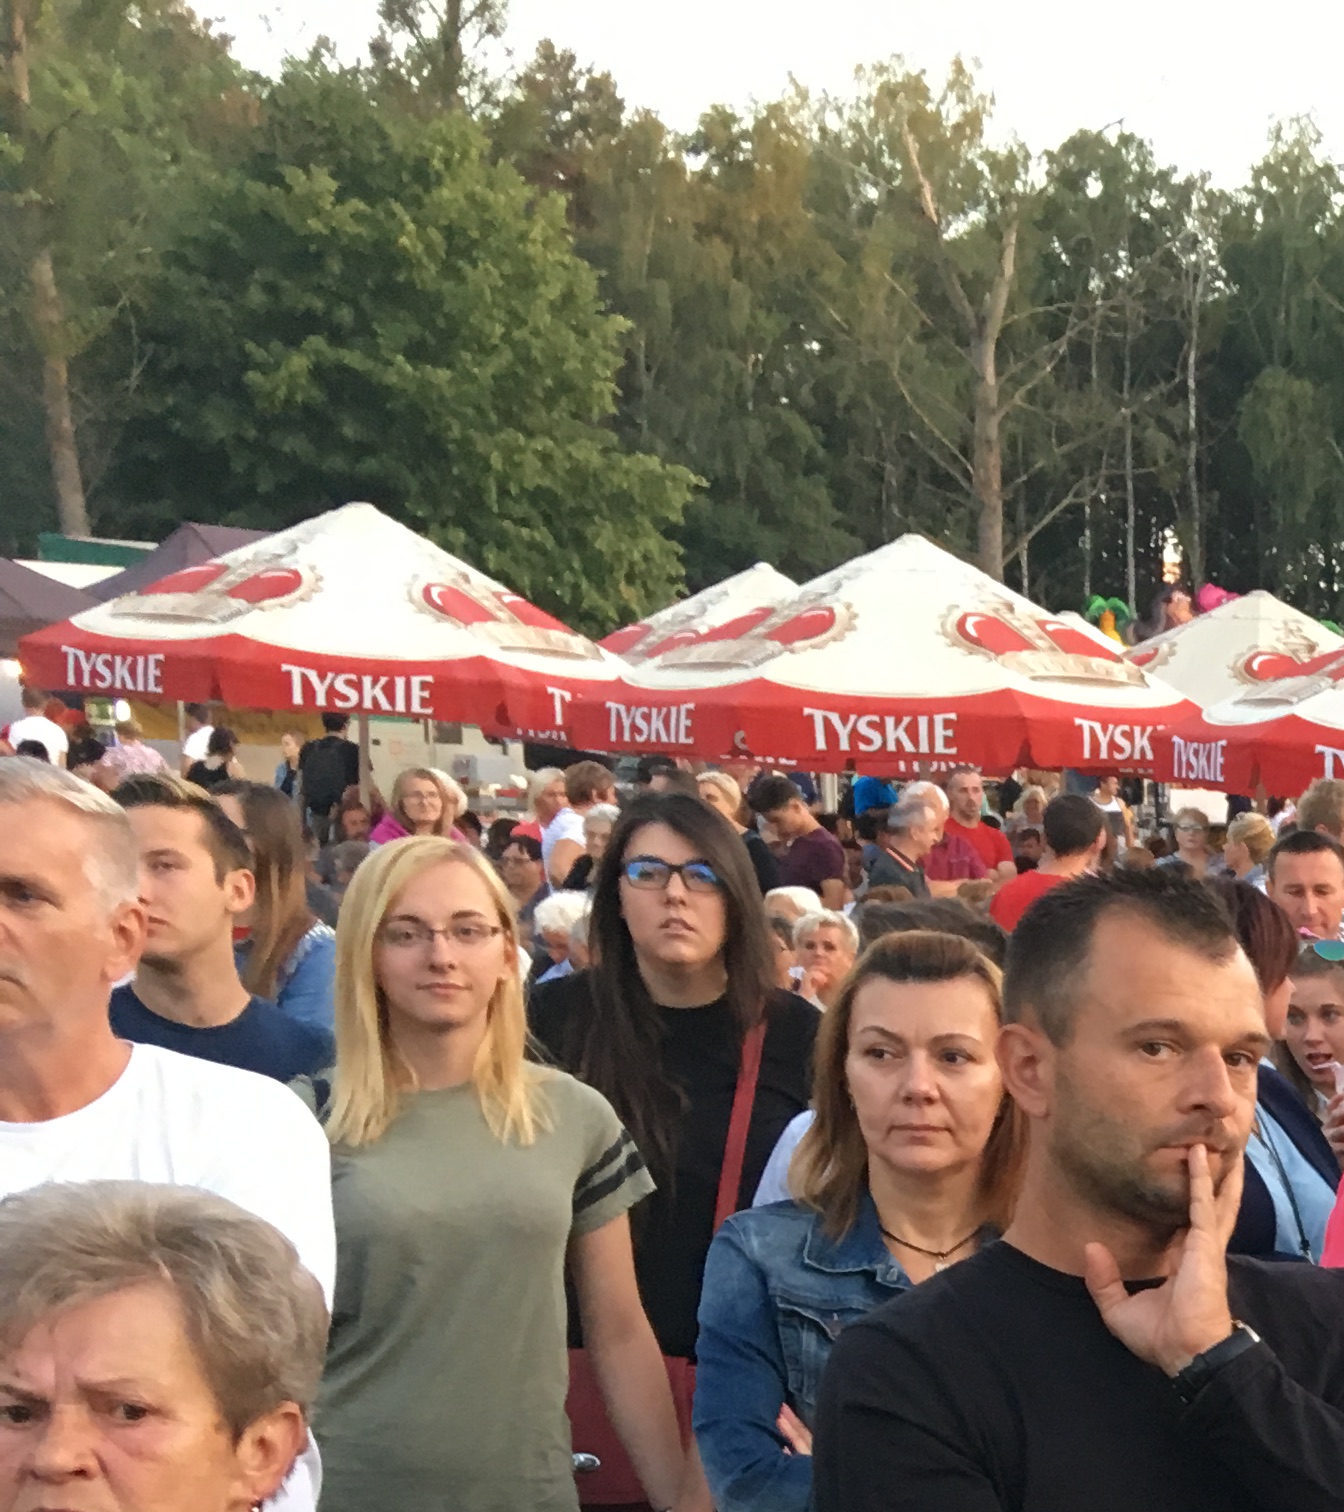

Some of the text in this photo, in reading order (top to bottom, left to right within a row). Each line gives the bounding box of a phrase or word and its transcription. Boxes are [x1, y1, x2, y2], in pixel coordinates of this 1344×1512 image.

[61, 644, 166, 694] TYSKIE
[280, 663, 435, 715] TYSKIE
[605, 701, 696, 744] TYSKIE
[803, 707, 958, 755] TYSKIE
[1073, 717, 1164, 761] TYSK
[1171, 735, 1228, 782] TYSKIE
